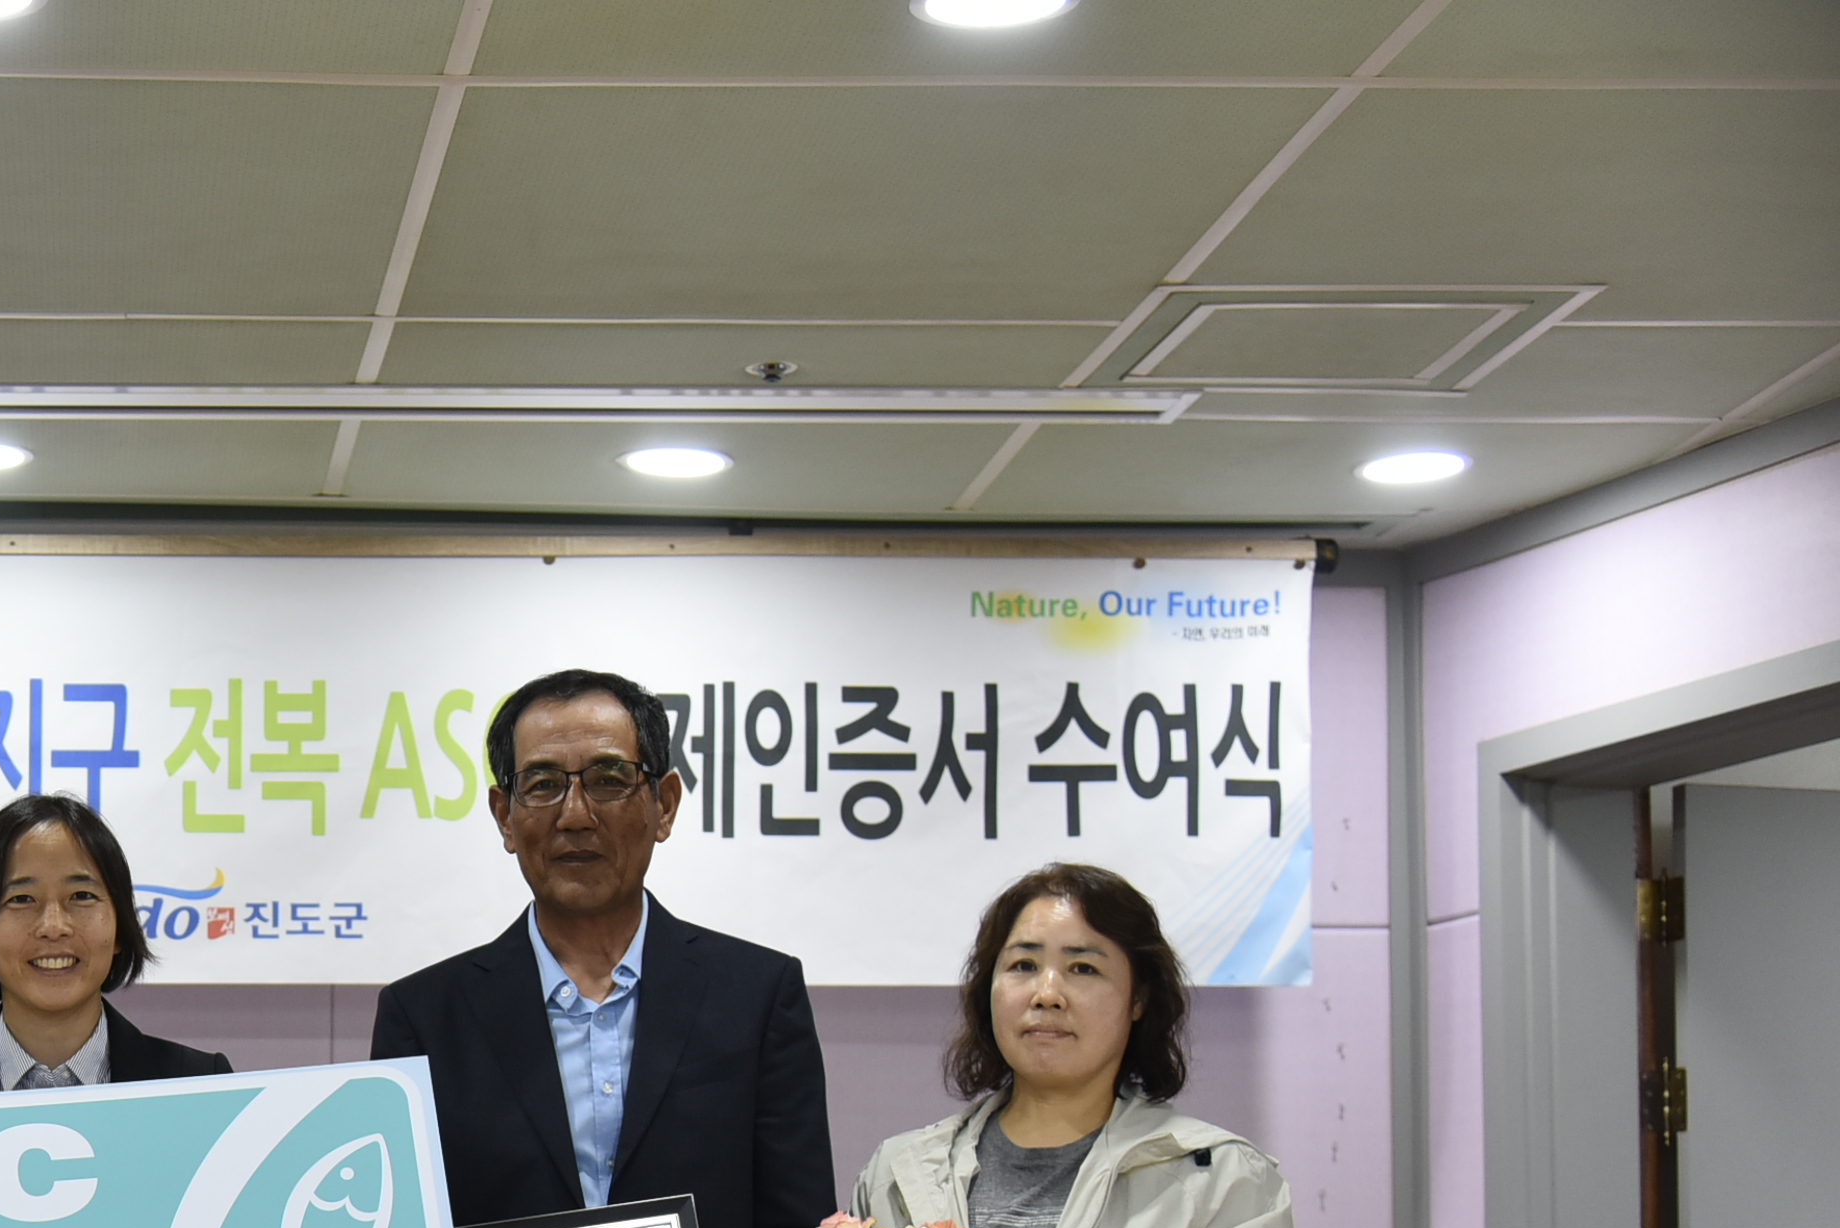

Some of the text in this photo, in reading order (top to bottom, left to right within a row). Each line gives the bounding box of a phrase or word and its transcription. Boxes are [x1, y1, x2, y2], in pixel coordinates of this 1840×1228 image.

[970, 589, 1282, 621] Nature, Our Future!
[163, 678, 340, 837] 전복
[360, 688, 517, 821] AS
[1028, 681, 1282, 838] 수여식
[243, 901, 368, 939] 진도군
